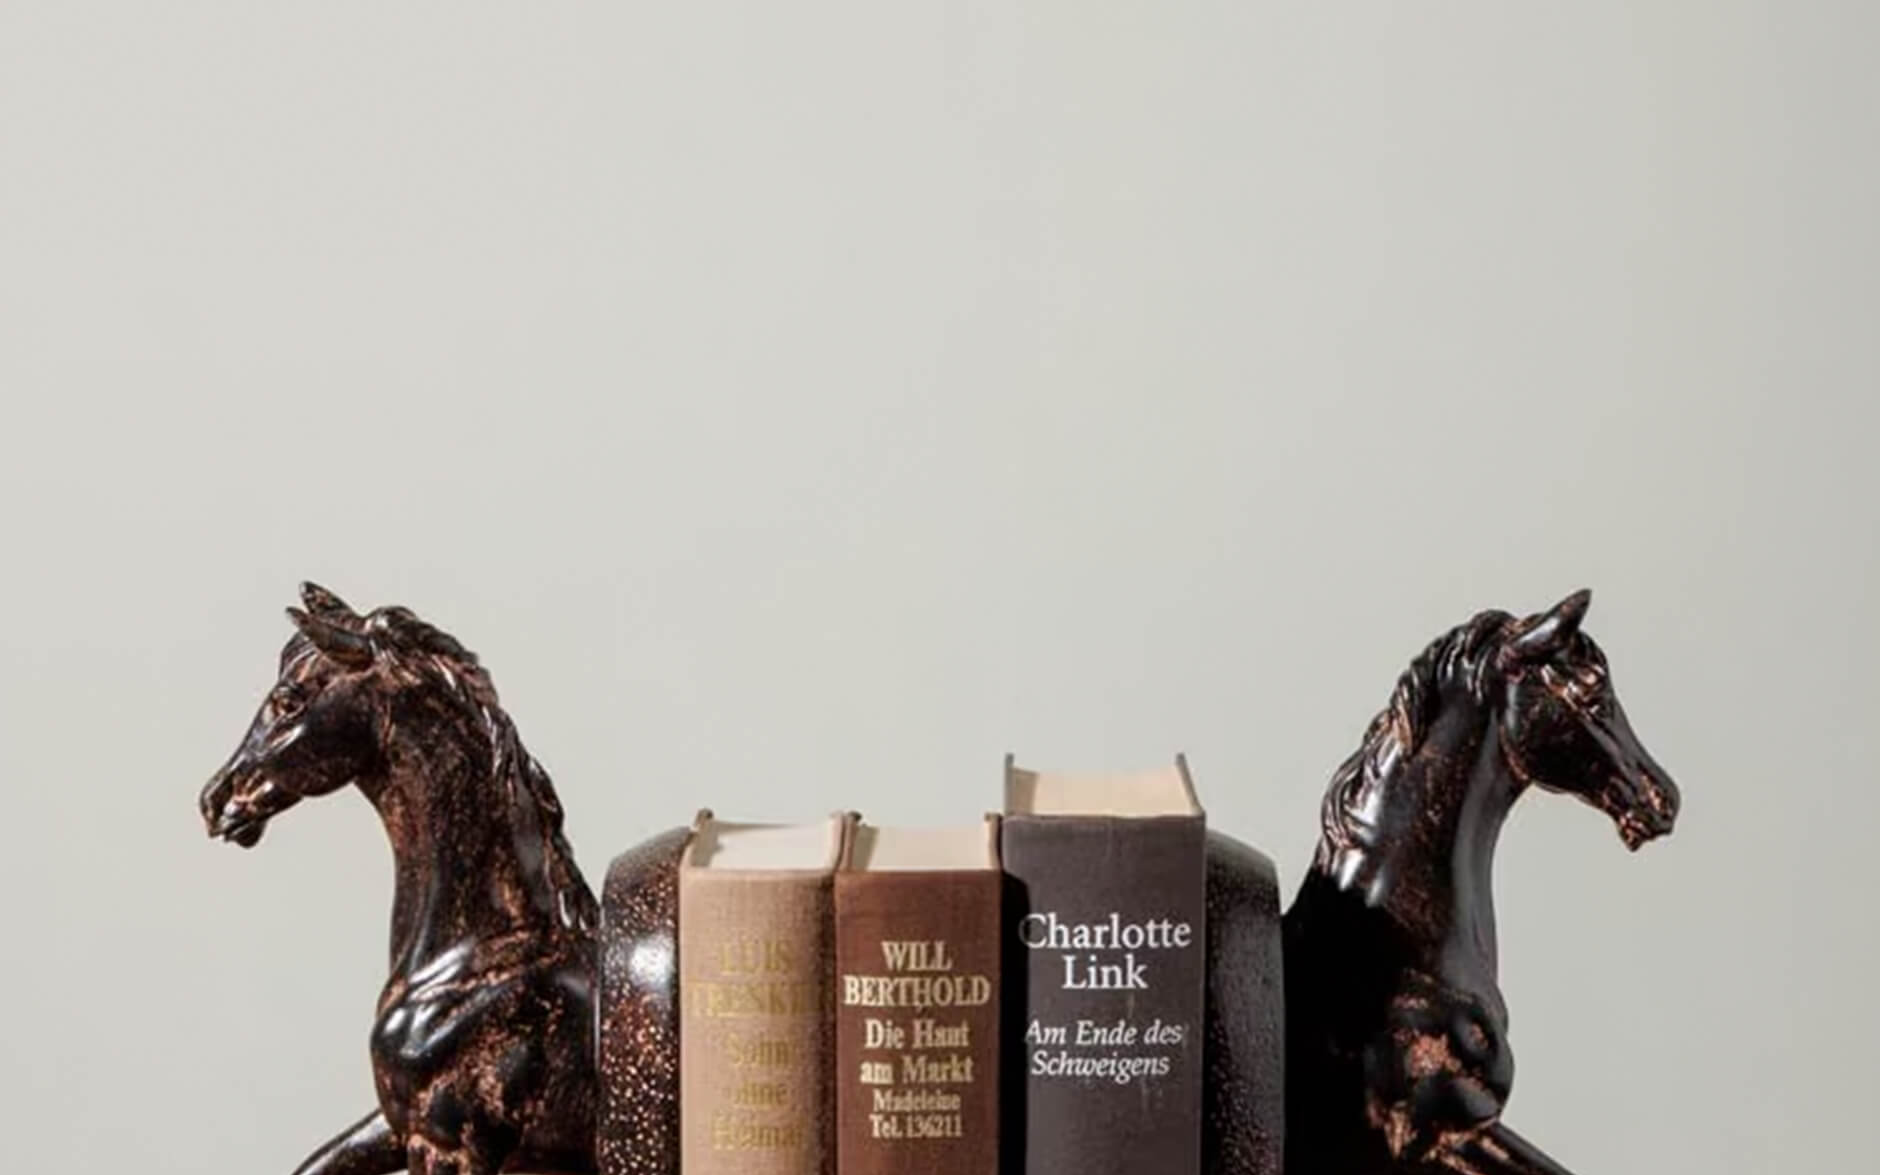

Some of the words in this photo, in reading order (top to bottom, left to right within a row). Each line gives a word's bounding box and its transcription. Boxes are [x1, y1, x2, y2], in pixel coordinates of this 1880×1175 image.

[1019, 912, 1192, 949] Charlotte
[881, 940, 953, 971] WILL
[1062, 953, 1149, 990] Link
[844, 974, 991, 1007] BERTHOLD
[865, 1018, 905, 1048] Die
[912, 1018, 970, 1048] Haut
[1024, 1019, 1067, 1045] Am
[1075, 1019, 1138, 1046] Ende
[1144, 1018, 1183, 1045] des
[860, 1061, 894, 1084] am
[901, 1054, 974, 1083] Markt
[1031, 1050, 1171, 1085] Schweigens
